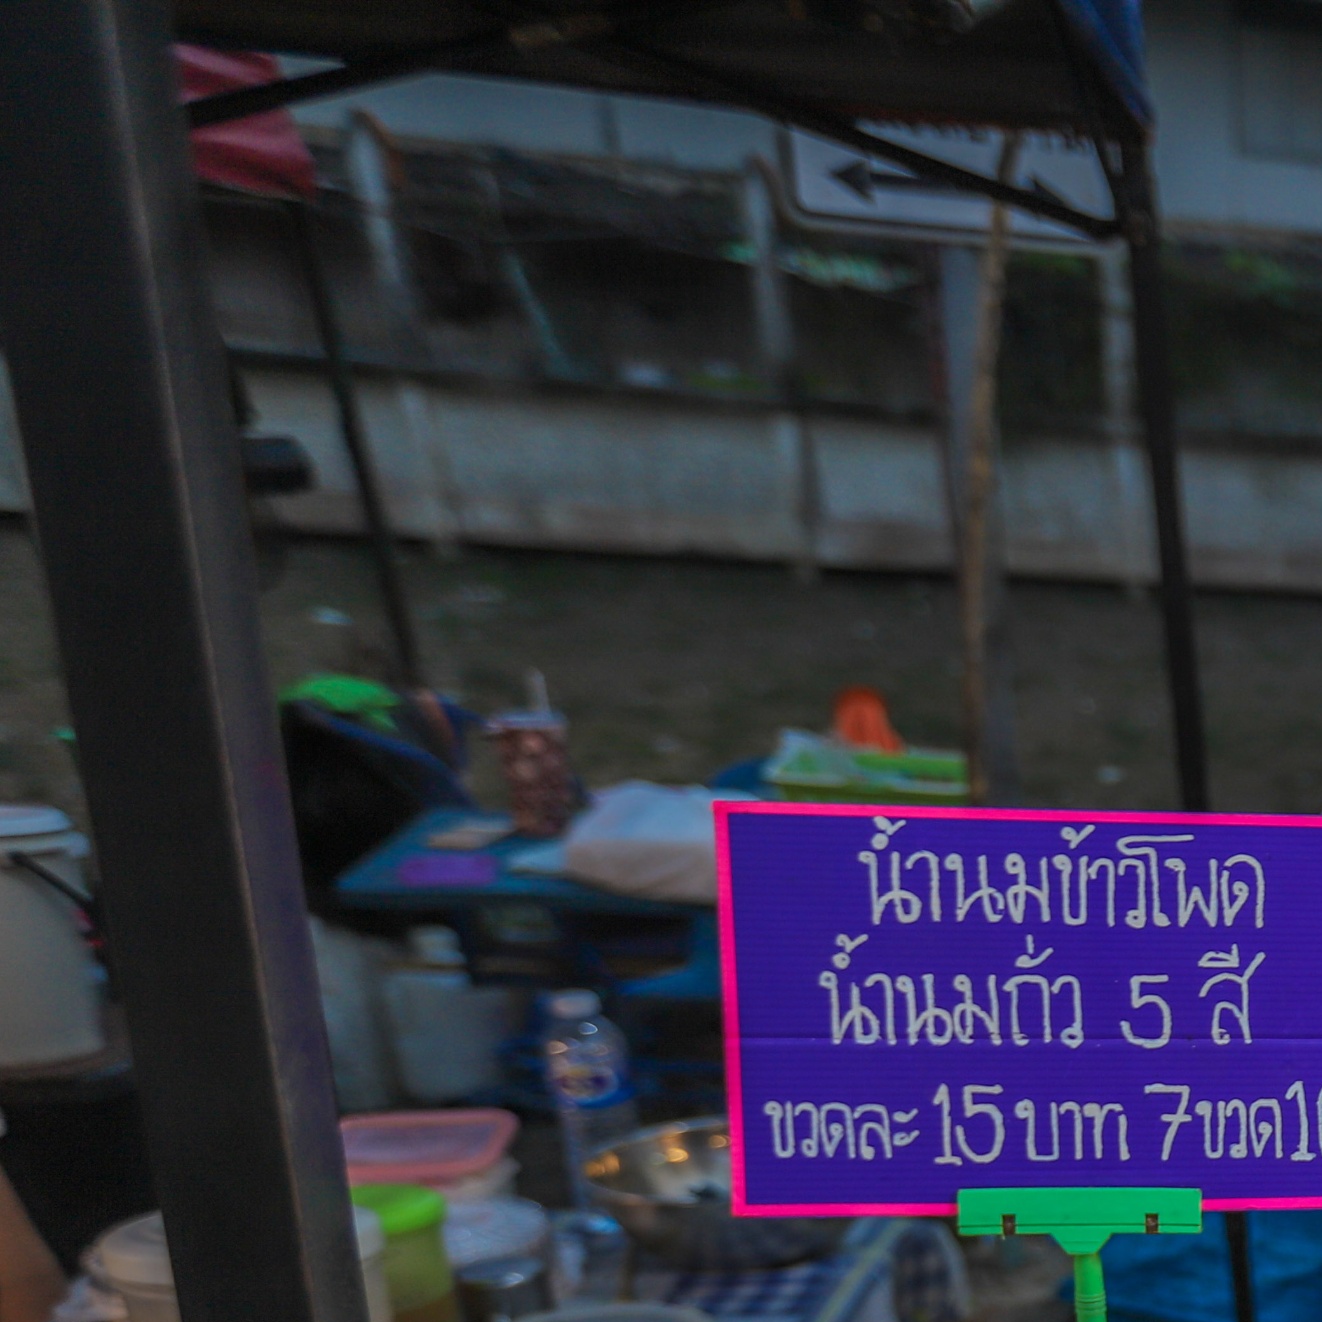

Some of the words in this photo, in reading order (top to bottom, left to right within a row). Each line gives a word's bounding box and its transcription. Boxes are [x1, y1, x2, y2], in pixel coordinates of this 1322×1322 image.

[858, 816, 1266, 929] น้ำนมข้าวโพด
[818, 933, 1085, 1049] น้ำนมถั่ว
[1119, 974, 1173, 1050] 5
[1197, 944, 1266, 1047] สี
[763, 1099, 920, 1163] ขวดละ
